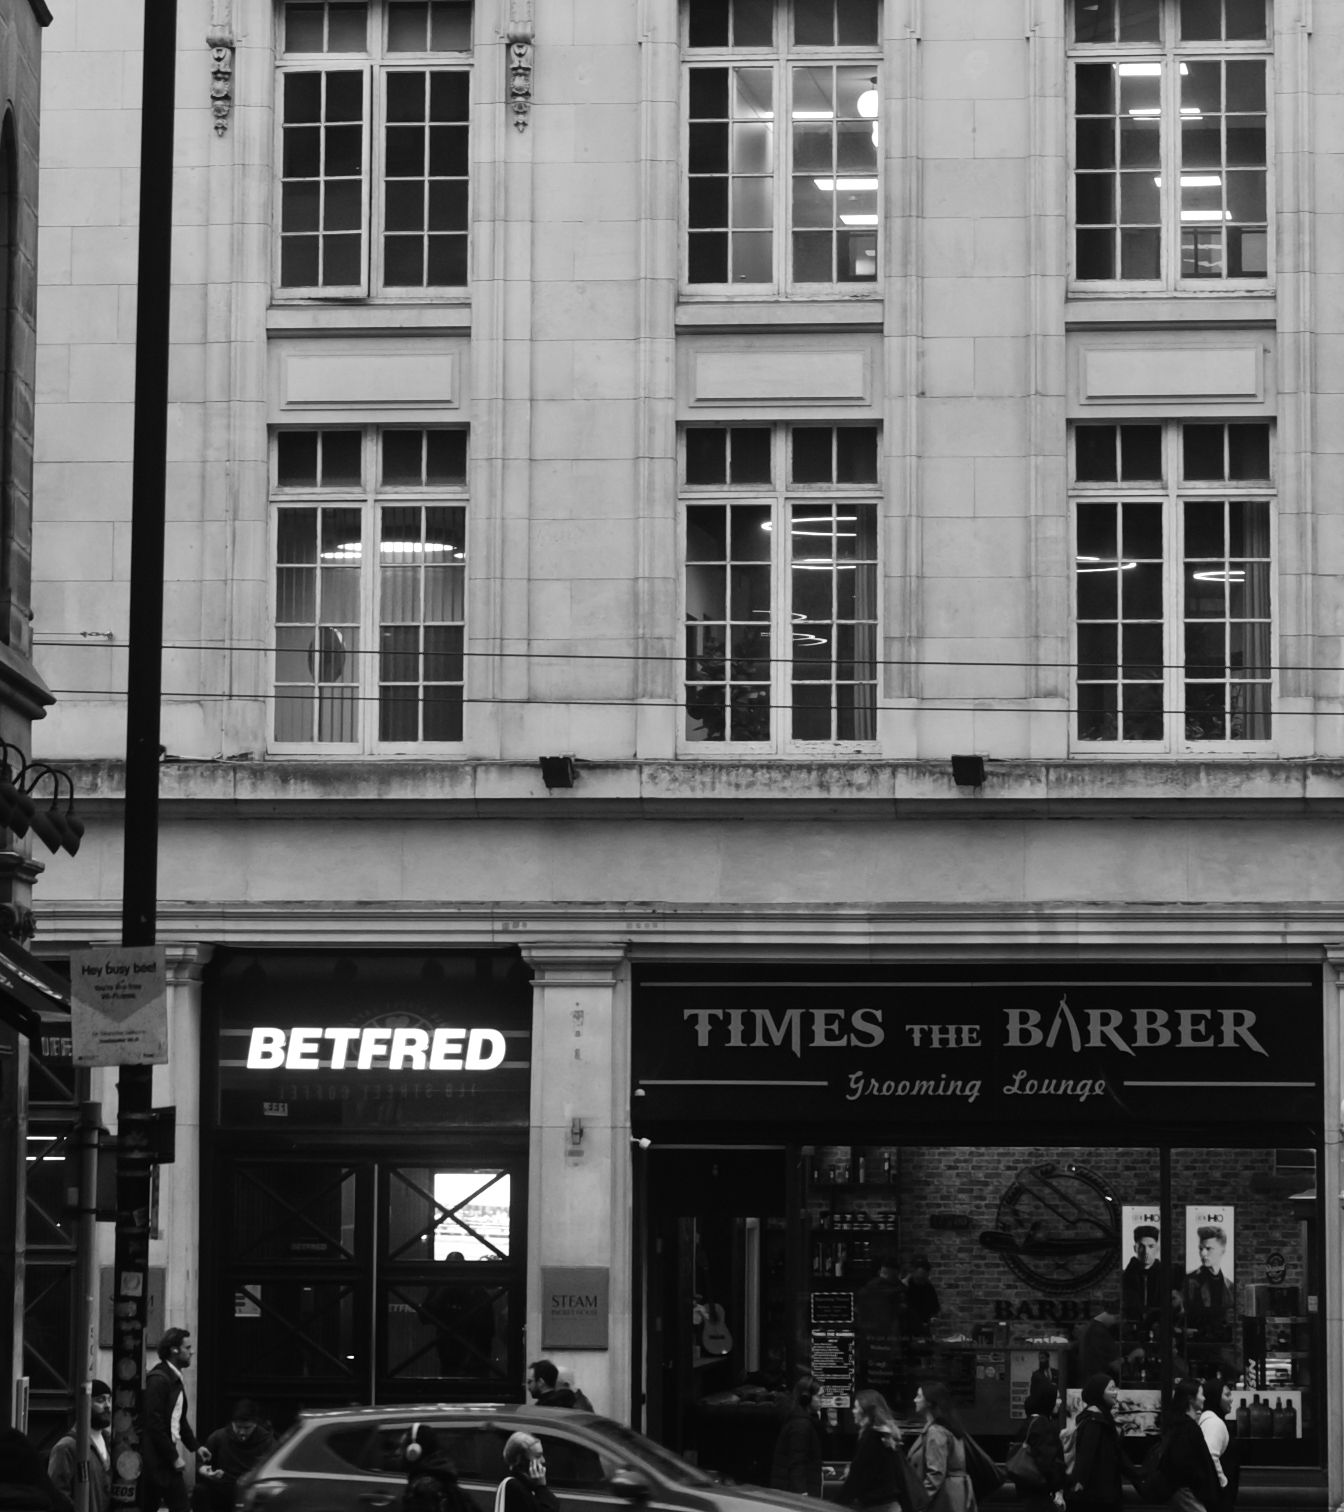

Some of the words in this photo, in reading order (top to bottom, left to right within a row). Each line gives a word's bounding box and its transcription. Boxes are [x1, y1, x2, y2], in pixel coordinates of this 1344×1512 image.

[81, 965, 103, 977] Hey
[105, 961, 131, 976] busy
[683, 1008, 886, 1058] TIMES
[905, 1024, 983, 1048] THE
[1002, 993, 1270, 1058] BARBER
[246, 1026, 507, 1071] BETFRED
[845, 1070, 983, 1104] Grooming
[1003, 1069, 1106, 1103] Lounge
[551, 1295, 598, 1308] STEAM
